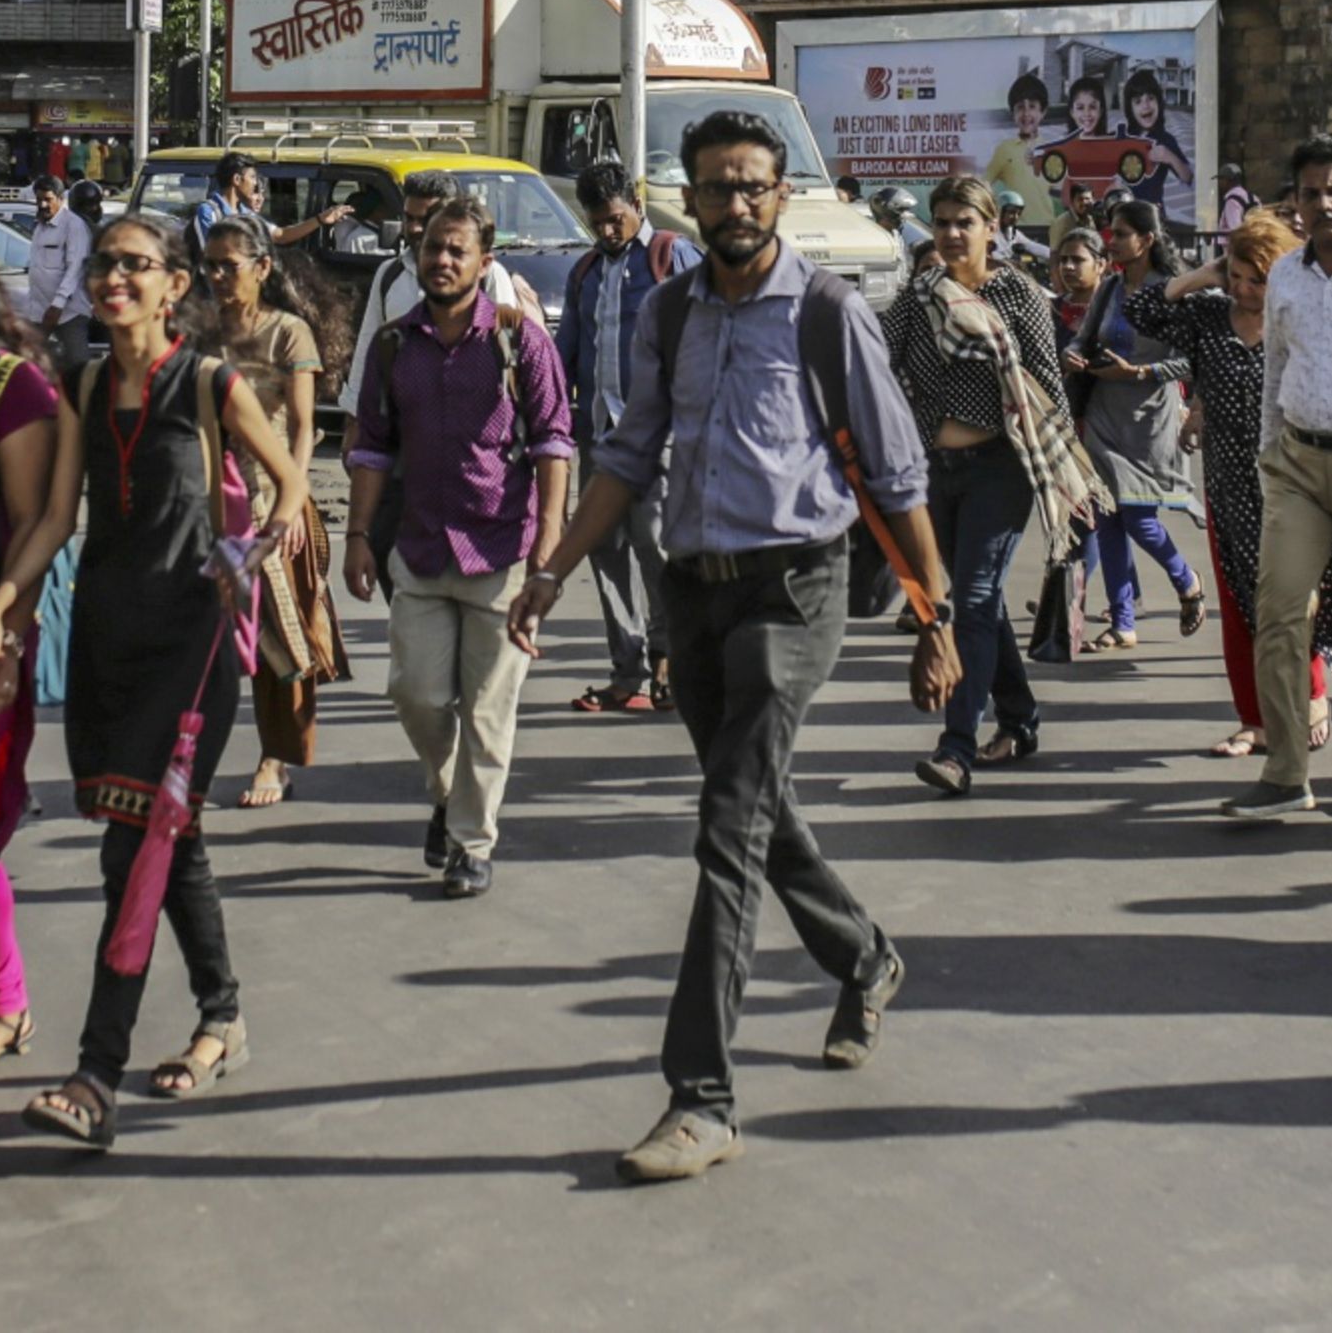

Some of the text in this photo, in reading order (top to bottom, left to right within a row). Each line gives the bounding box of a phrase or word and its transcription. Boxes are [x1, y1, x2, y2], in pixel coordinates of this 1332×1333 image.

[833, 113, 968, 134] AN EXCITING LONG DRIVE
[837, 136, 862, 154] JUST
[865, 135, 885, 154] GOT
[887, 135, 896, 154] A
[898, 135, 917, 154] LOT
[851, 160, 949, 175] BARODA CAR LOAN
